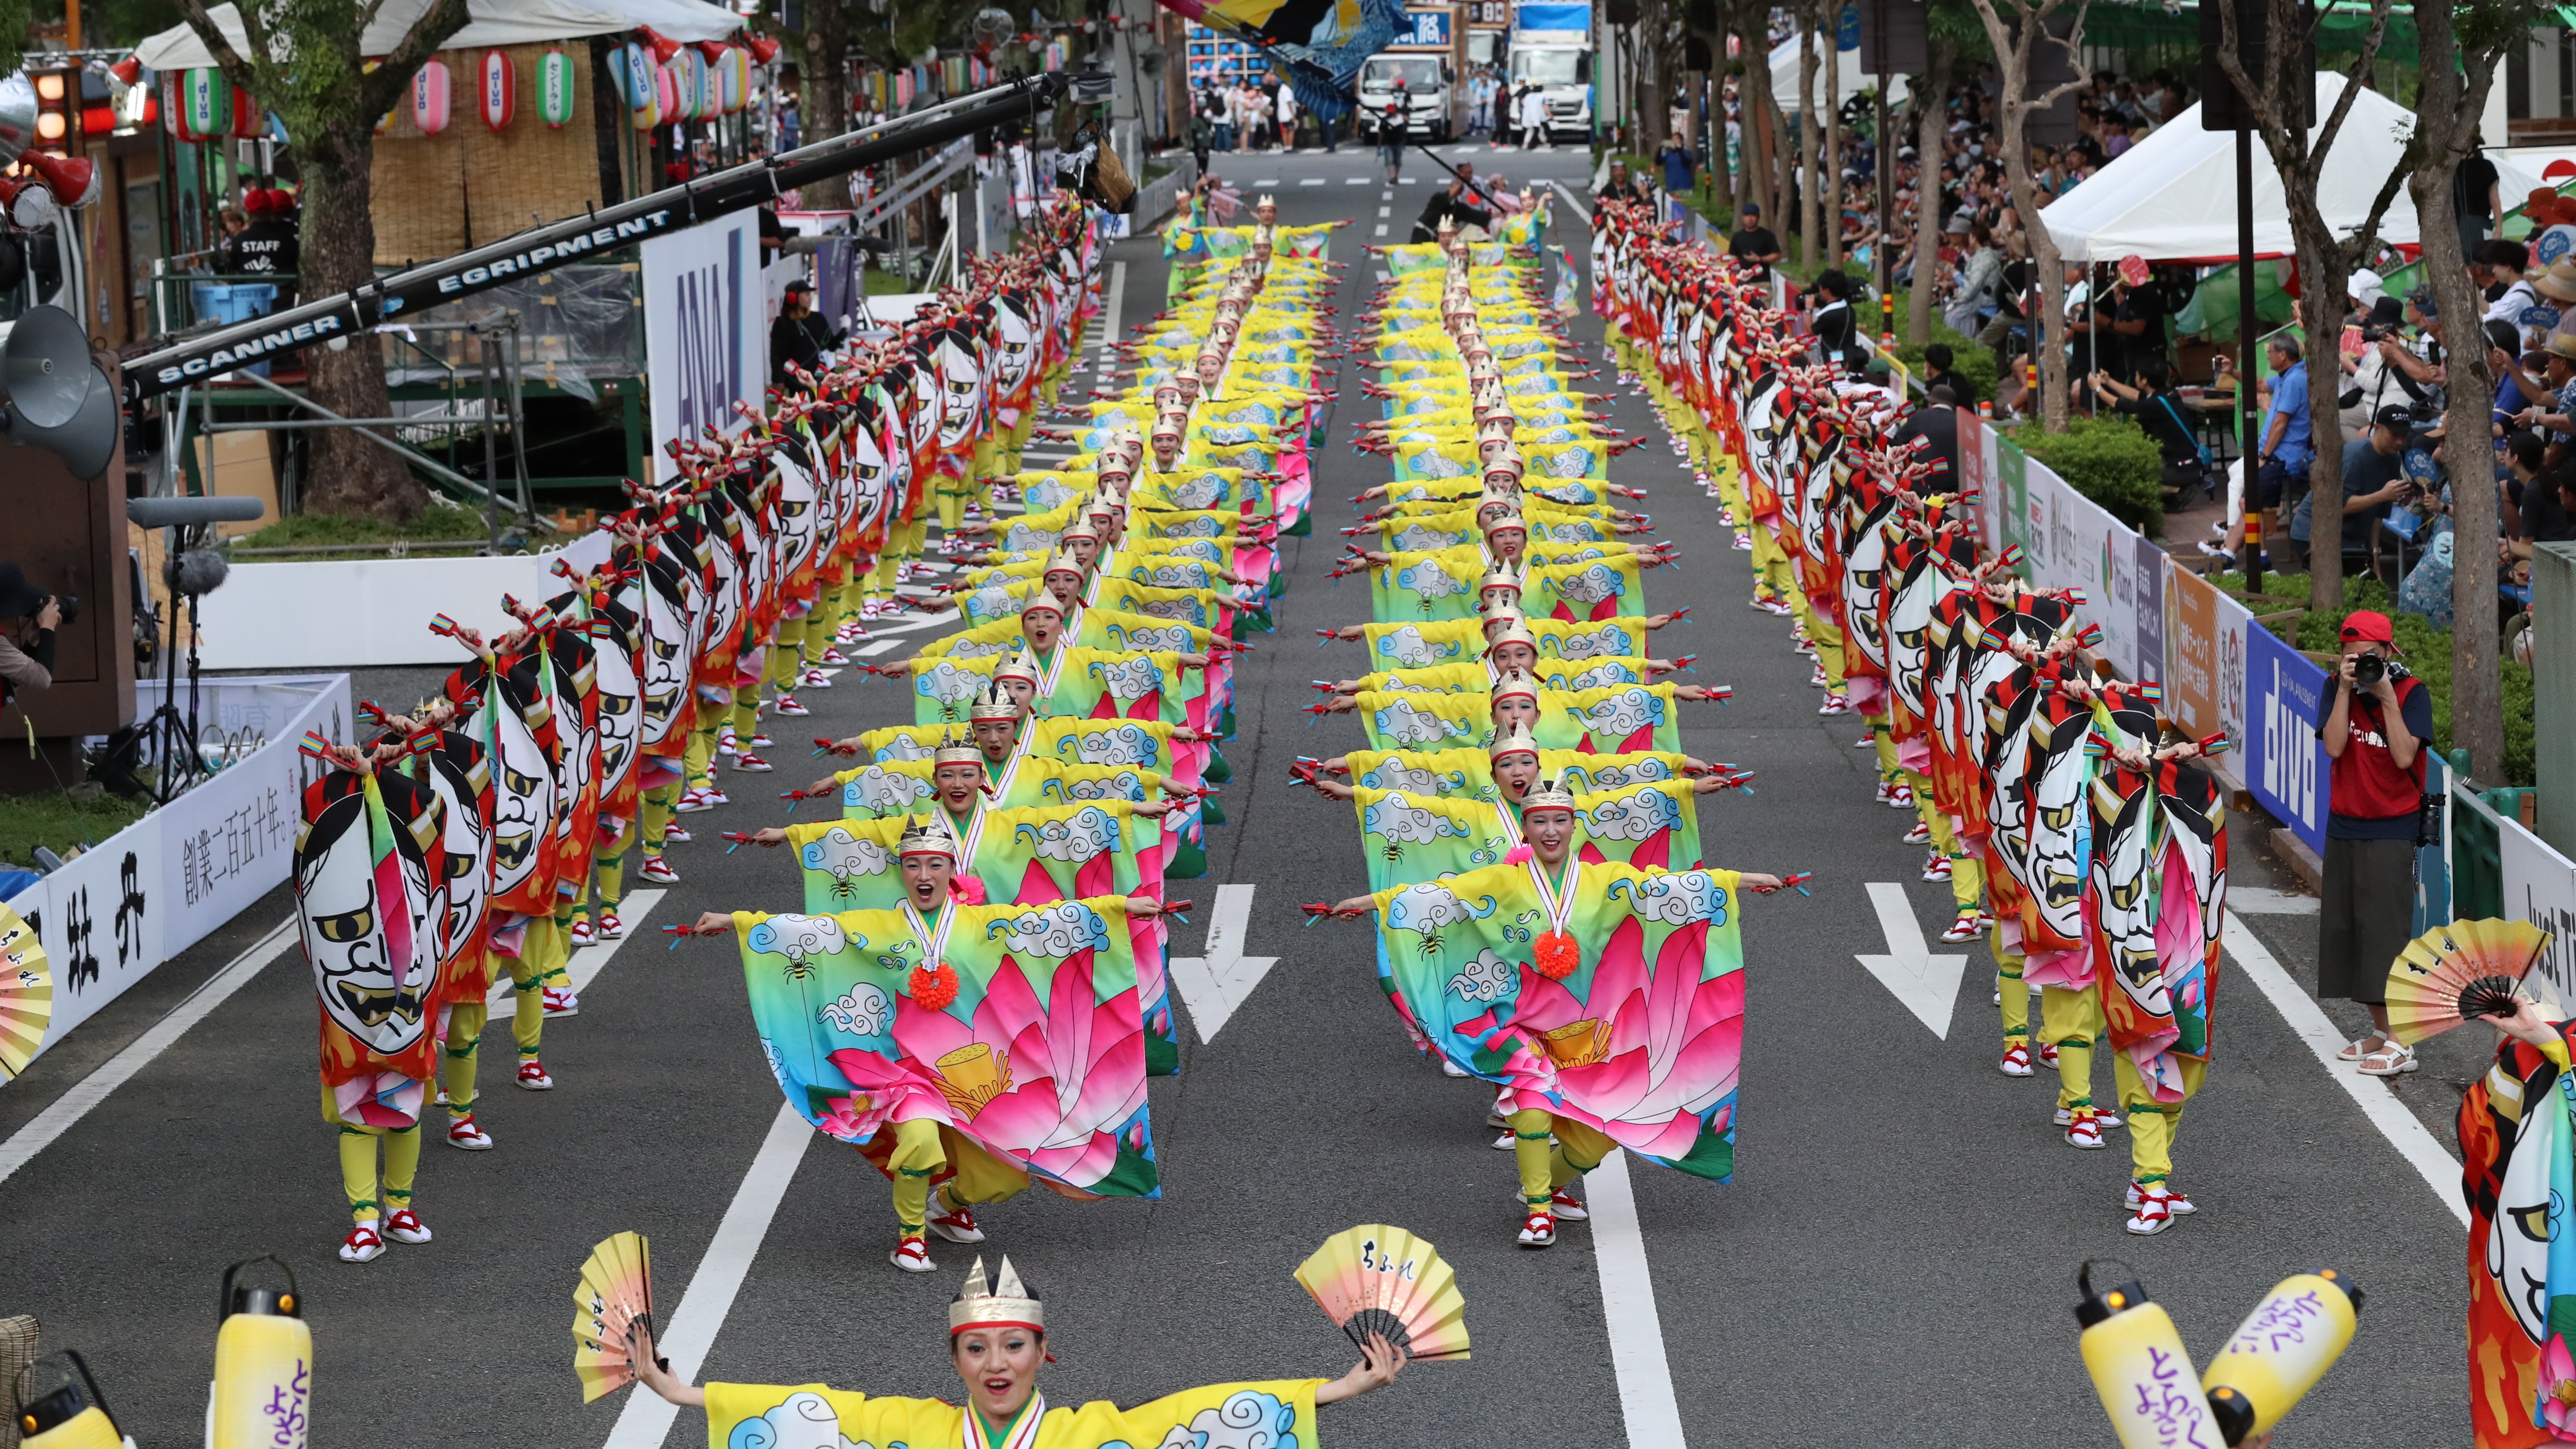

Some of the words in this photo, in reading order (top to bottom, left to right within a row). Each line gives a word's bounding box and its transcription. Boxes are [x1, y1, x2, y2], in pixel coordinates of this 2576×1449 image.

[550, 62, 558, 111] セントラル
[242, 240, 281, 252] STAFF
[438, 209, 670, 292] EGRIPMENT
[158, 315, 341, 384] SCANNER
[1363, 1240, 1414, 1280] ちふれ
